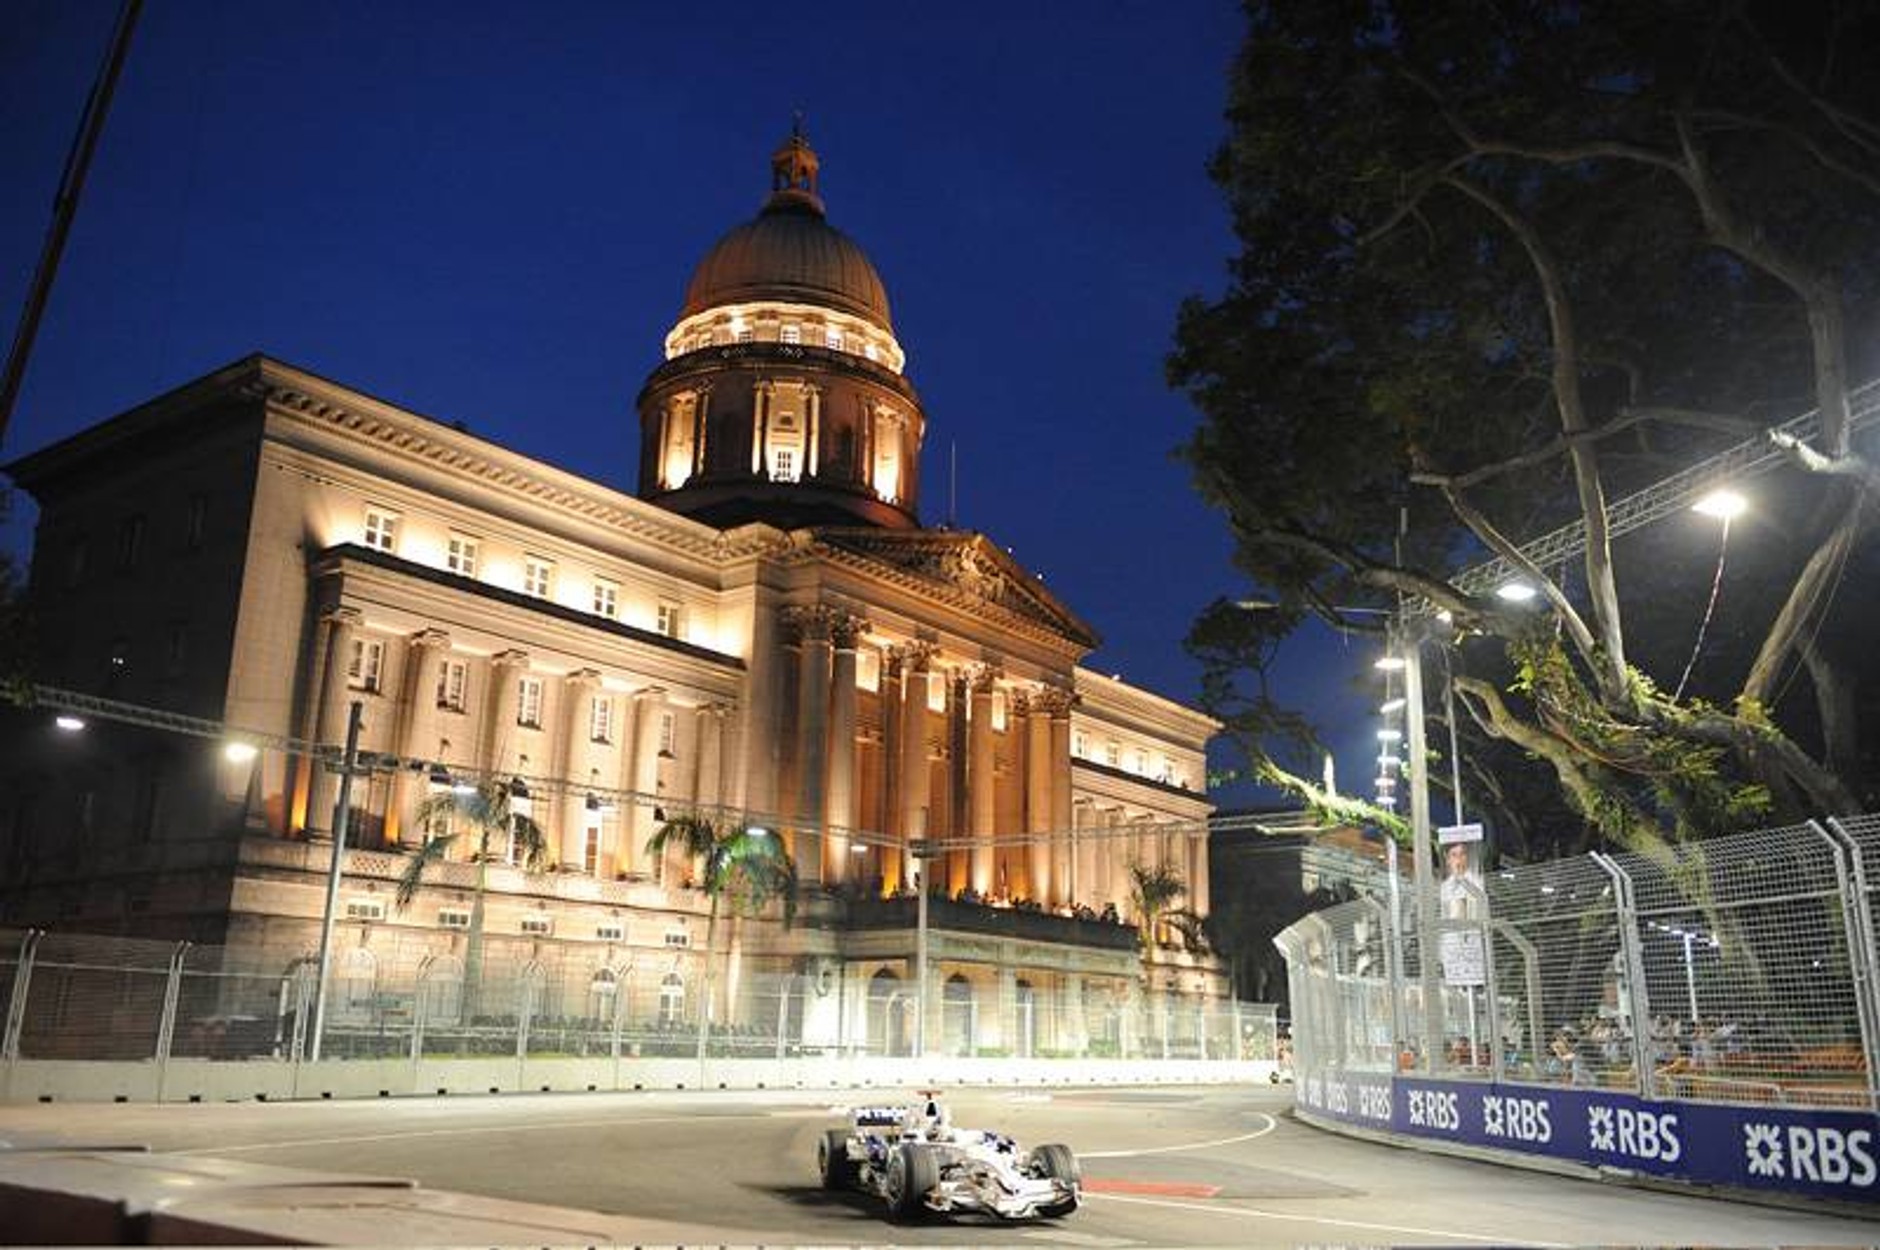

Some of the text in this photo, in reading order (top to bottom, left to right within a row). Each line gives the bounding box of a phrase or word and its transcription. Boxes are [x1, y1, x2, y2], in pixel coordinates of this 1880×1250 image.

[1426, 1090, 1460, 1130] RBS
[1506, 1097, 1552, 1143] RBS
[1617, 1108, 1681, 1163] RBS
[1788, 1126, 1877, 1187] RBS
